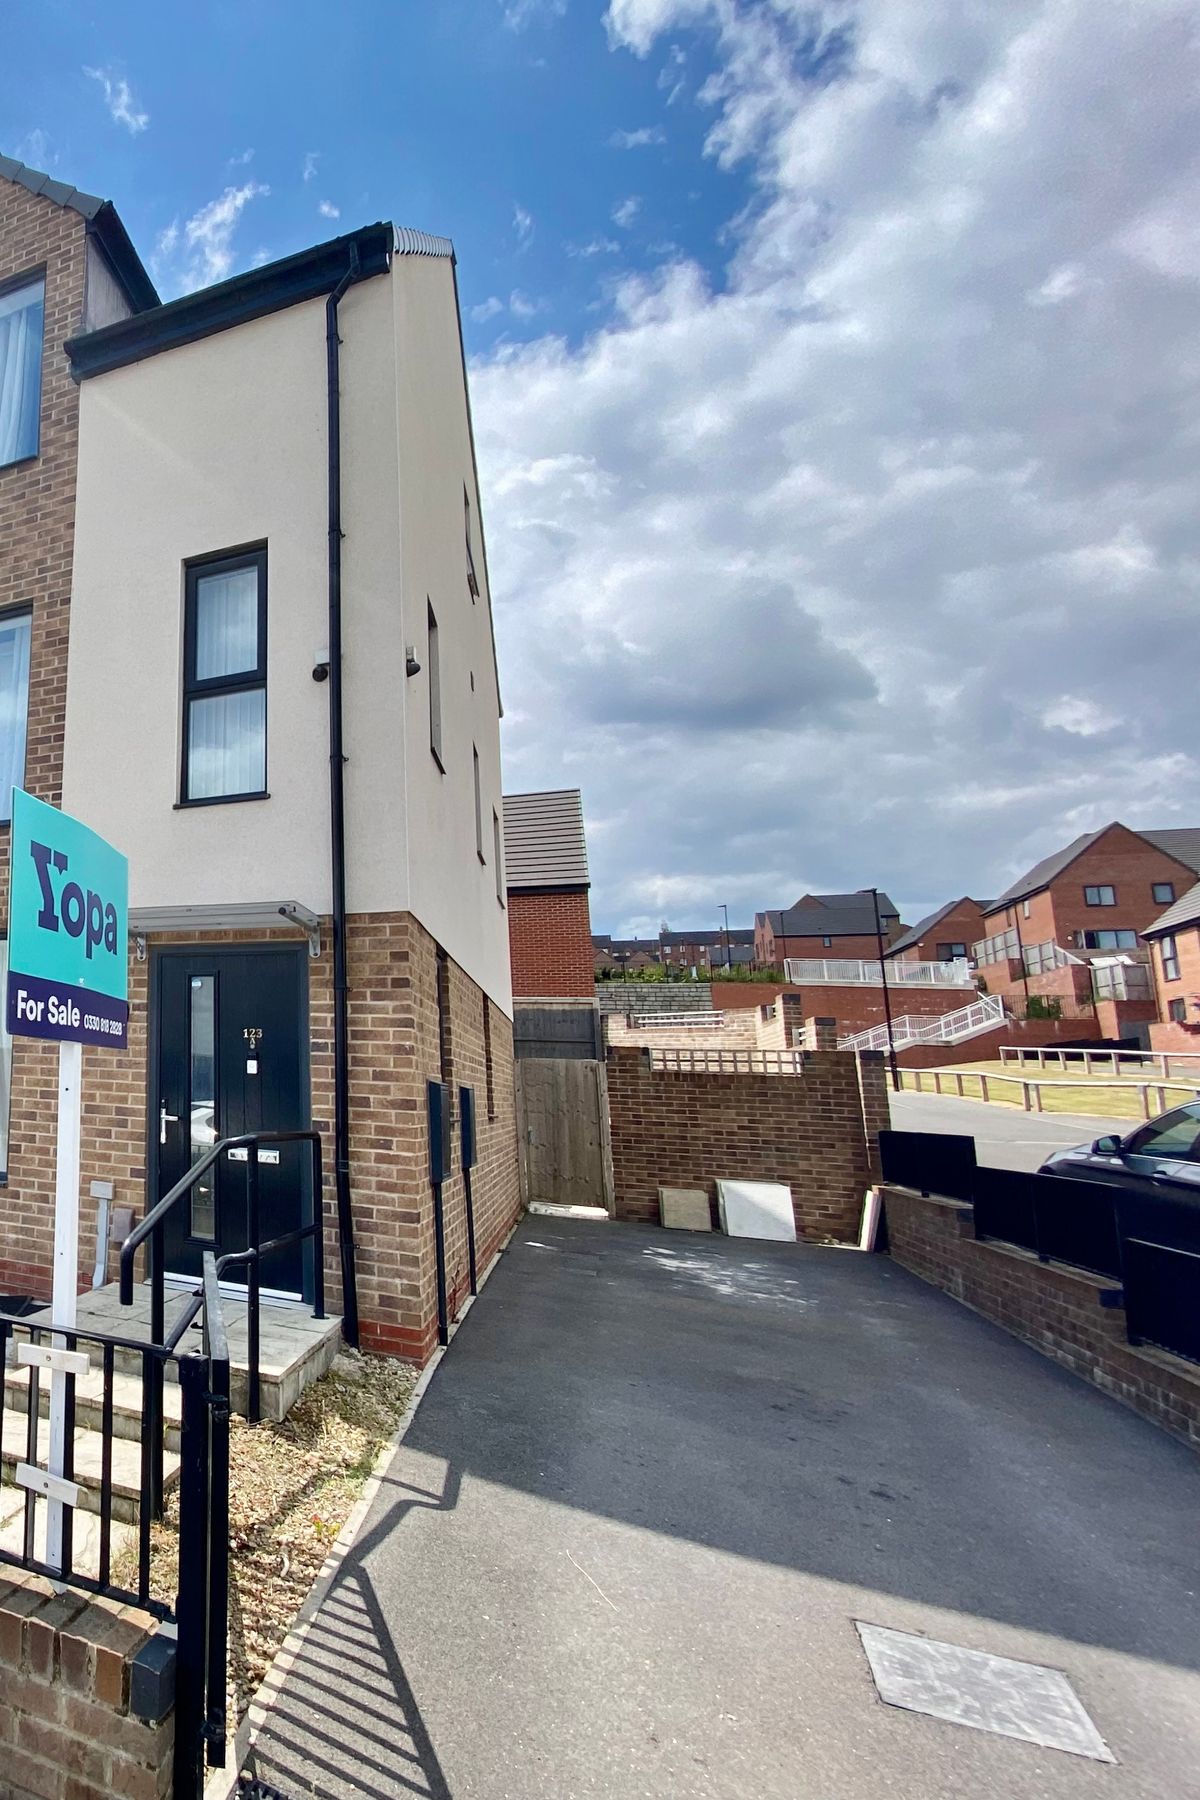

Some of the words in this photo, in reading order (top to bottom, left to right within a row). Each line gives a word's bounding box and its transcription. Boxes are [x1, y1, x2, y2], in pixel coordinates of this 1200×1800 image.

[31, 840, 118, 960] Yopa
[17, 989, 44, 1022] For
[48, 995, 80, 1028] Sale
[83, 1014, 100, 1031] 0330
[243, 1028, 263, 1039] 123
